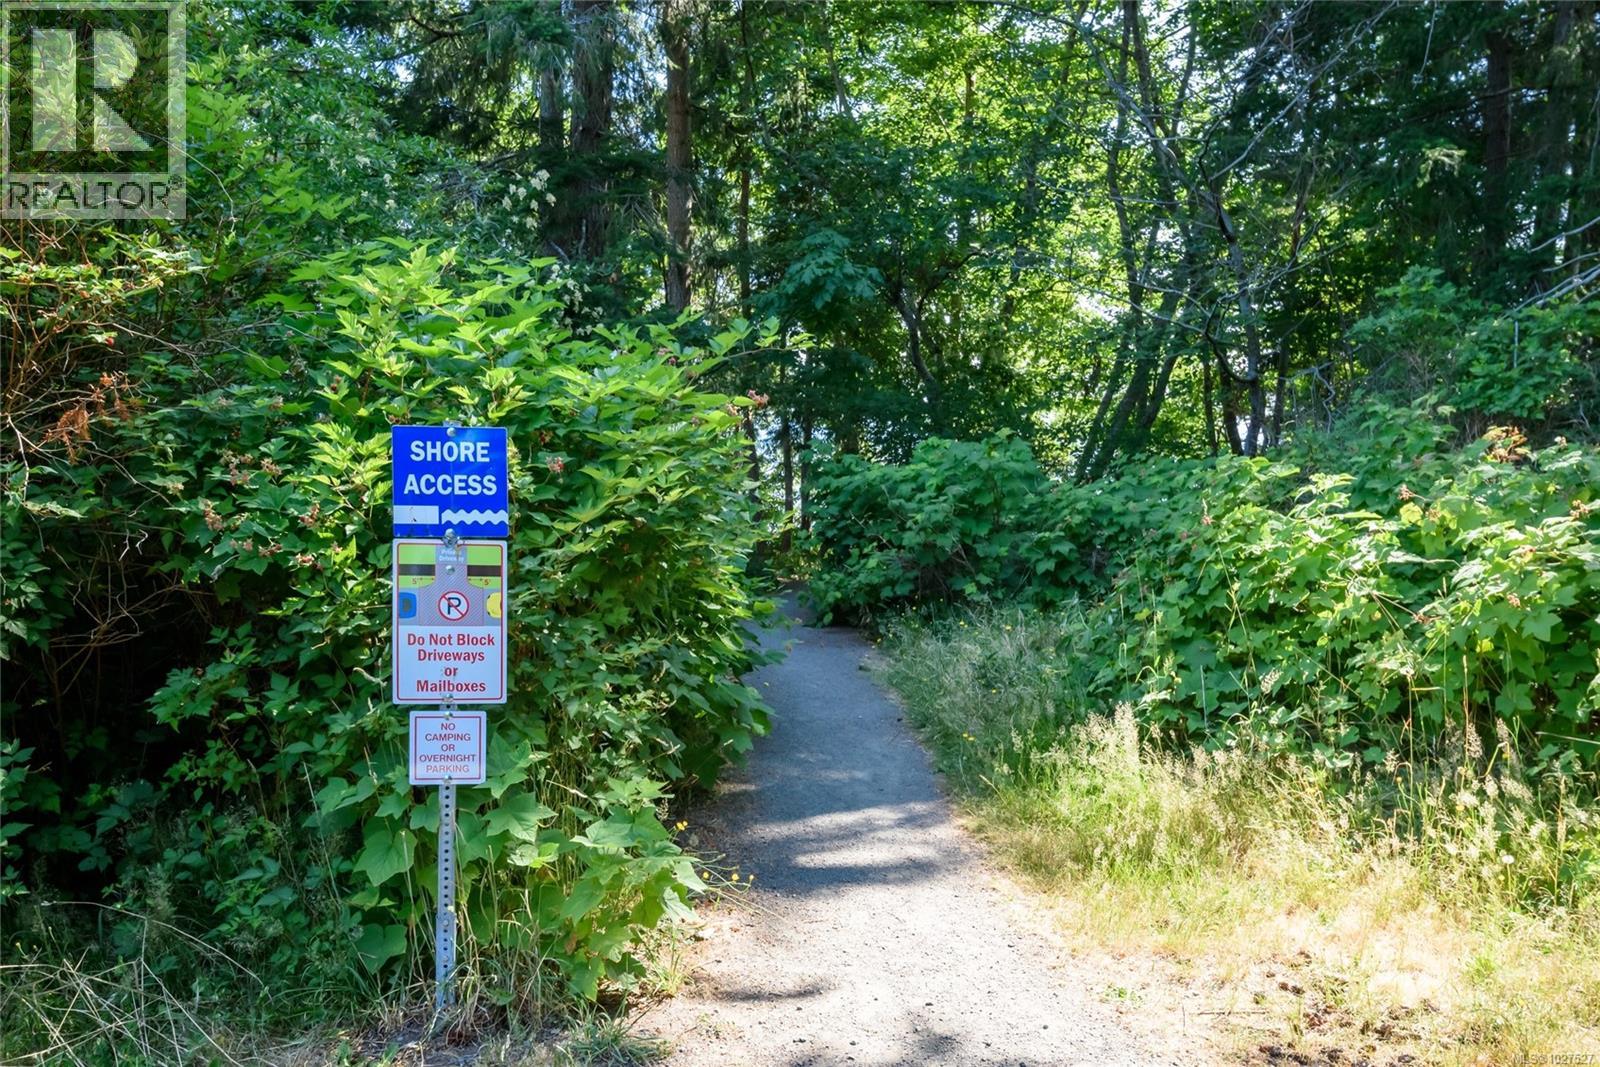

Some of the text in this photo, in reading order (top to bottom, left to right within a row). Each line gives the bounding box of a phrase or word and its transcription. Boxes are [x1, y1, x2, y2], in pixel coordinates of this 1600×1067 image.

[410, 440, 490, 462] SHORE
[403, 474, 497, 496] ACCESS
[407, 633, 495, 646] Do Not Block
[418, 649, 485, 664] Driveways
[444, 667, 458, 676] or
[416, 680, 486, 692] Mailboxes
[441, 723, 456, 731] NO
[425, 733, 471, 742] CAMPING
[441, 744, 455, 752] OR
[419, 754, 476, 763] OVERNIGHT
[426, 764, 470, 773] PARKING
